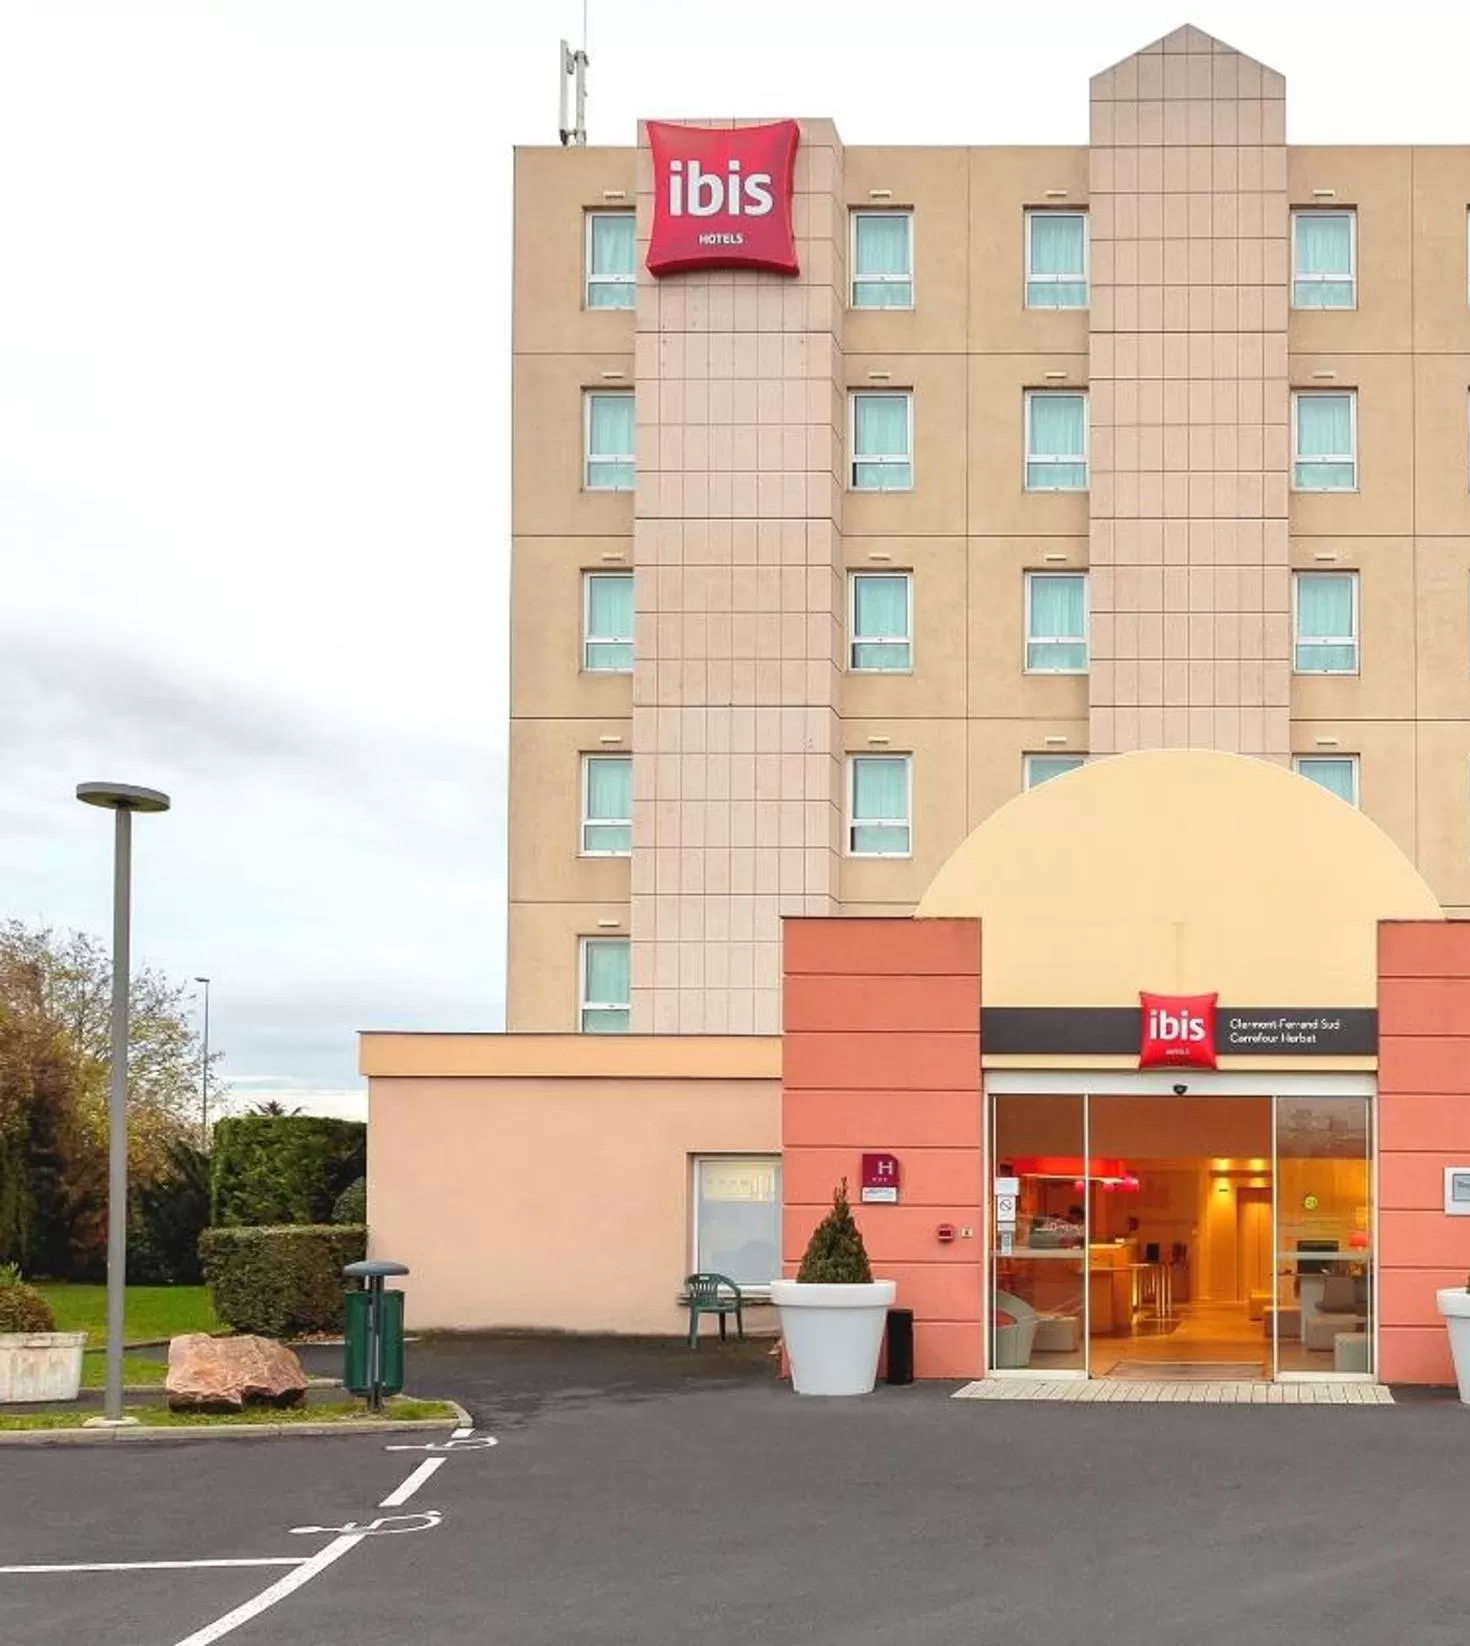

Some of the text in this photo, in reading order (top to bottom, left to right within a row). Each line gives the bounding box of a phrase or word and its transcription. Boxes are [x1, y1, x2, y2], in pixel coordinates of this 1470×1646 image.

[667, 159, 774, 217] ibis
[699, 232, 744, 245] HOTELS
[1149, 1008, 1206, 1041] ibis
[1320, 1018, 1340, 1030] Sud
[877, 1160, 893, 1175] H
